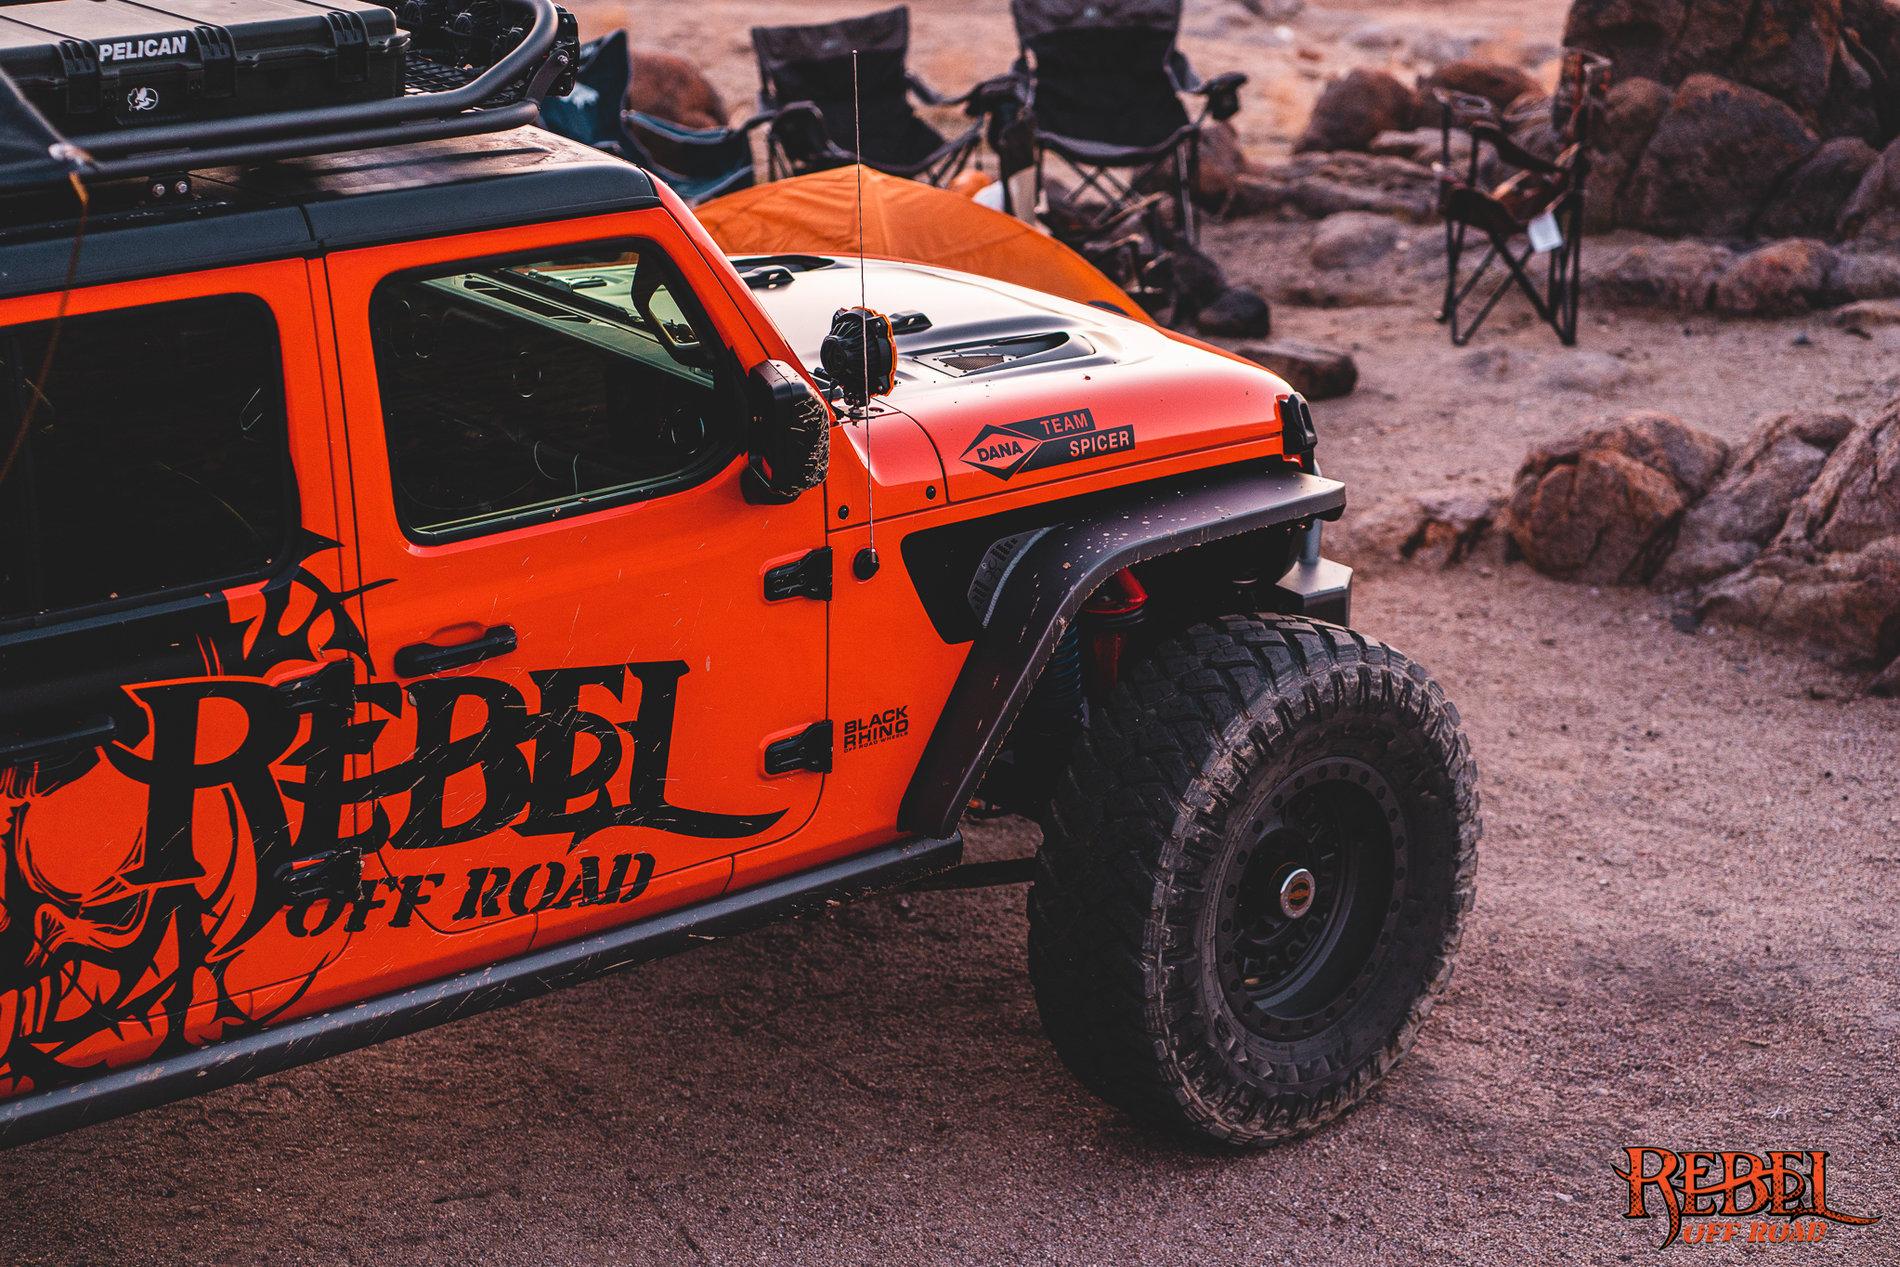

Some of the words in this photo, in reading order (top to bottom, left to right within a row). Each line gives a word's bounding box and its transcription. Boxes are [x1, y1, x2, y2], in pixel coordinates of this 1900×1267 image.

[99, 35, 187, 62] PELICAN
[1040, 413, 1088, 435] TEAM
[977, 440, 1024, 462] DANA
[1069, 430, 1130, 457] SPICER
[844, 705, 908, 735] BLACK
[844, 719, 909, 749] RHINO
[104, 658, 790, 956] REBEL
[469, 853, 657, 921] ROAD
